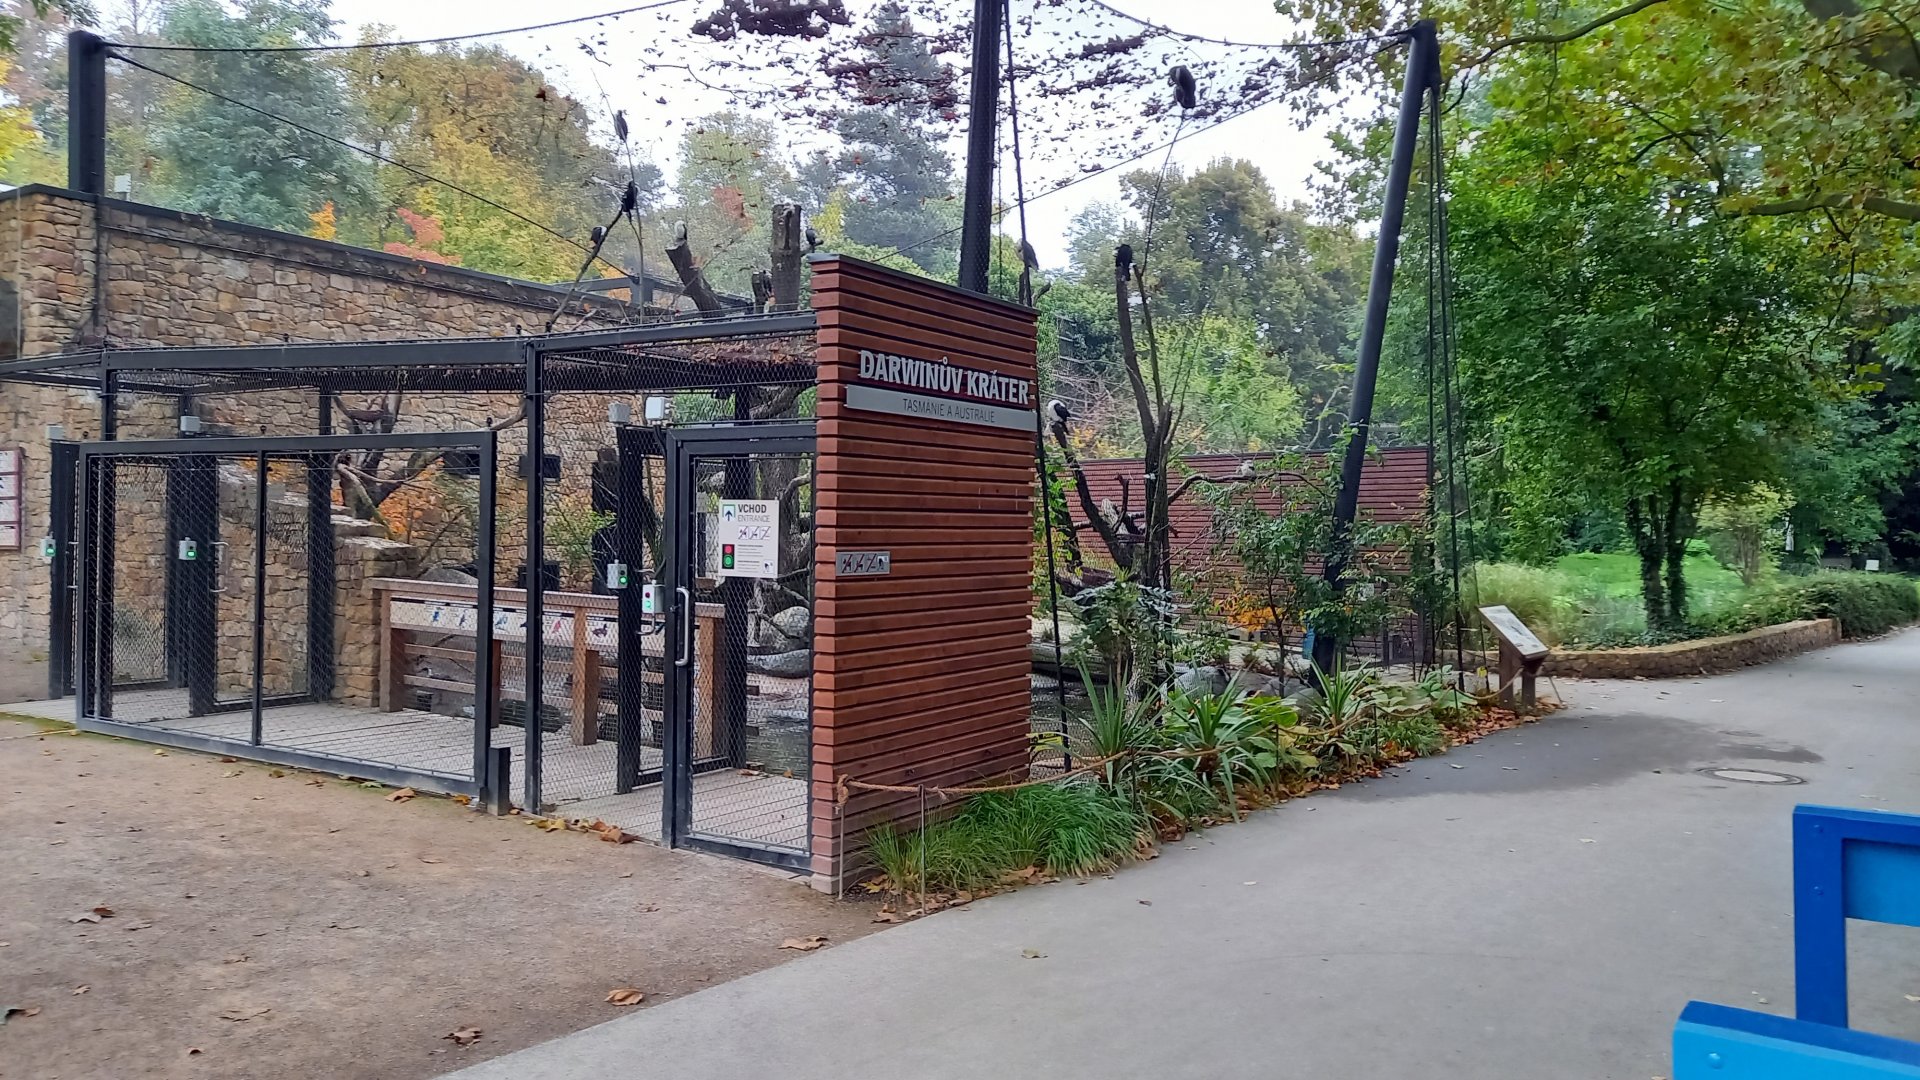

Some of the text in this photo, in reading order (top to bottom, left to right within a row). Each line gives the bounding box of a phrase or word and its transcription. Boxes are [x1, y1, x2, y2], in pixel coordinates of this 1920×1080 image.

[860, 350, 1029, 405] DARWINŮV KRÁTER
[946, 405, 953, 417] A
[738, 504, 767, 513] VCHOD
[738, 514, 770, 523] ENTRANCE
